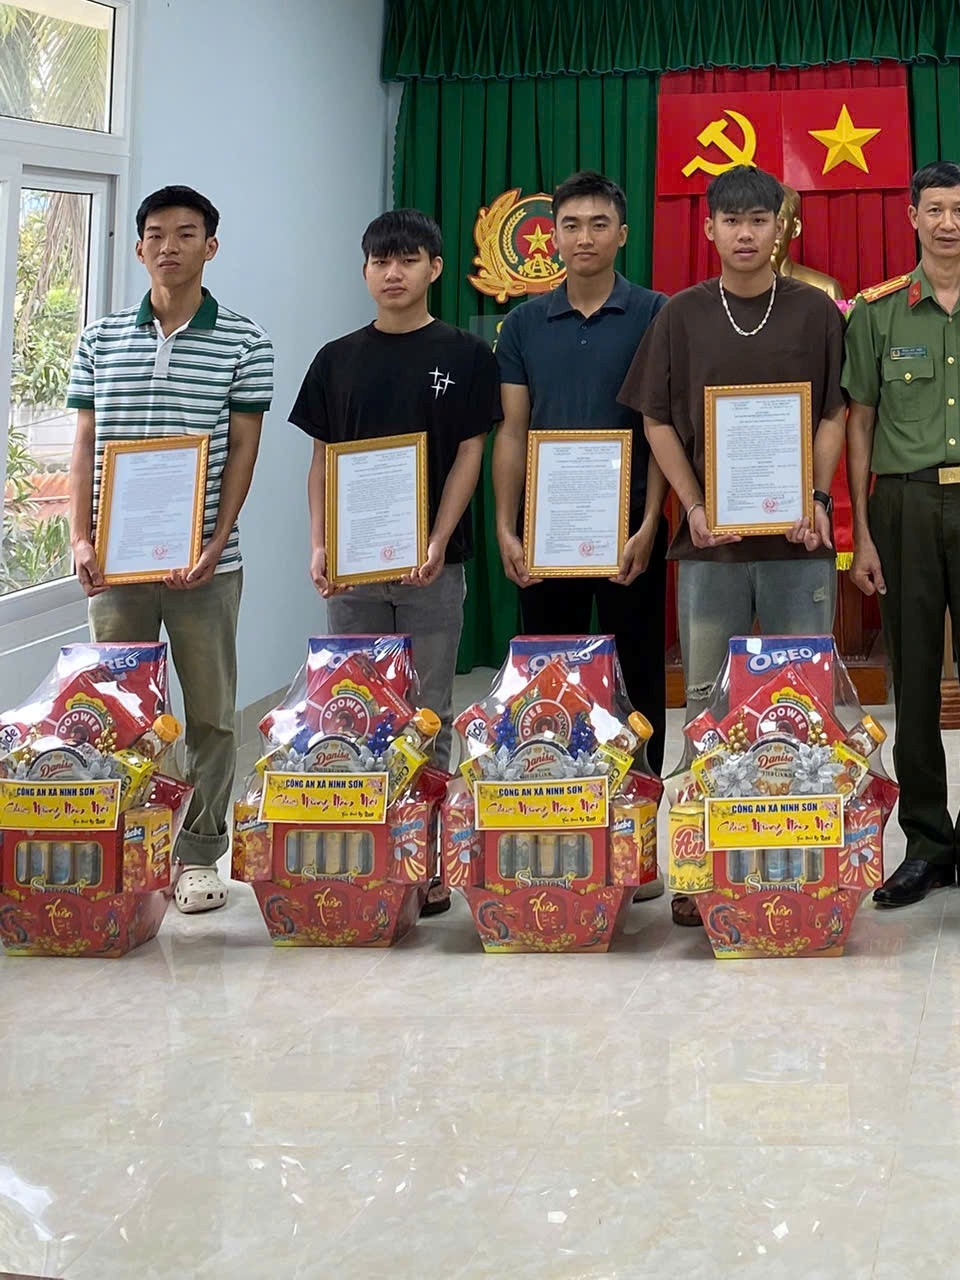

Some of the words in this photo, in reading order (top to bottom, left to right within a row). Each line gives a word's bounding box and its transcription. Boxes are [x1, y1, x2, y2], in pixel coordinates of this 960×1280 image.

[104, 657, 137, 671] REO
[749, 647, 813, 671] OREO
[324, 699, 365, 720] DOOWEE
[765, 707, 807, 730] OOWEE
[59, 712, 100, 734] DOOWEE
[523, 704, 543, 736] OWEE
[313, 749, 351, 767] Danisa
[758, 751, 794, 769] Danisa
[17, 787, 34, 796] CÔNG
[37, 788, 46, 796] AN
[60, 788, 77, 796] NINH
[80, 786, 95, 796] SƠN
[286, 778, 304, 788] CÔNG
[306, 778, 316, 788] AN
[328, 779, 346, 788] NINH
[348, 778, 364, 788] SƠN
[498, 787, 520, 797] CÔNG
[521, 787, 532, 796] AN
[546, 786, 564, 795] NINH
[566, 785, 583, 794] SƠN
[732, 804, 753, 814] CÔNG
[755, 804, 766, 812] AN
[780, 804, 800, 812] NINH
[802, 802, 818, 811] SƠN
